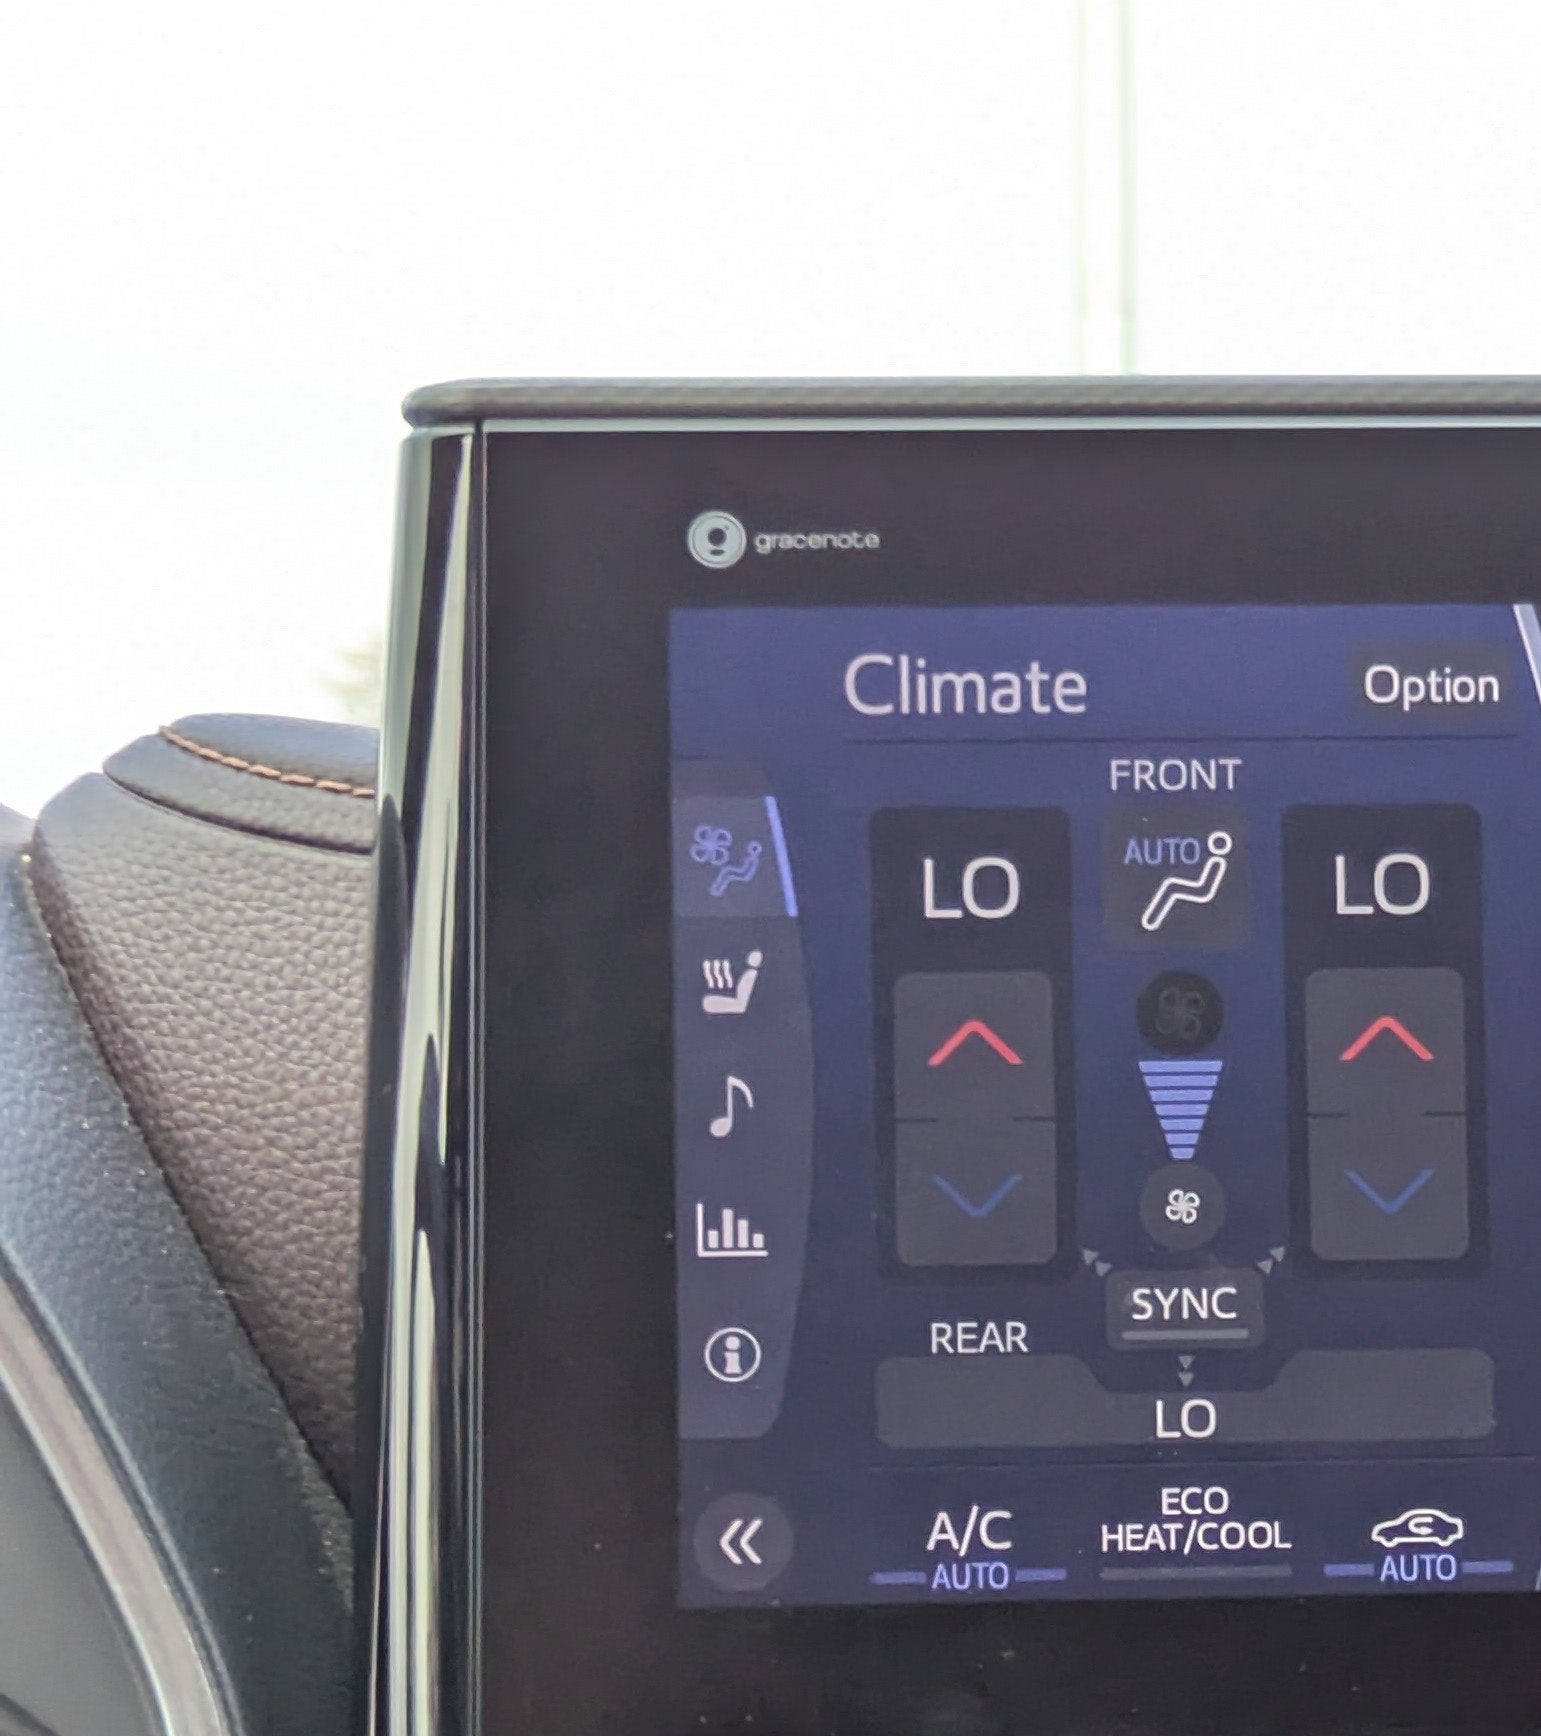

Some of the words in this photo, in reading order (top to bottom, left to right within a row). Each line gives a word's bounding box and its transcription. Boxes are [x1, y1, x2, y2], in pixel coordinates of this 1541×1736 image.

[755, 530, 880, 554] gracenote
[843, 653, 1088, 716] Climate
[1363, 665, 1500, 711] Option
[1110, 759, 1242, 792] FRONT
[1124, 836, 1200, 867] AUTO
[922, 855, 1020, 920] LO
[1334, 852, 1431, 917] LO
[1131, 1286, 1238, 1323] SYNC
[930, 1321, 1028, 1355] REAR
[1155, 1399, 1217, 1440] LO
[1160, 1487, 1230, 1516] ECO
[927, 1505, 1013, 1553] A/C
[1101, 1520, 1292, 1553] HEAT/COOL
[931, 1562, 1010, 1591] AUTO
[1379, 1554, 1457, 1583] AUTO
